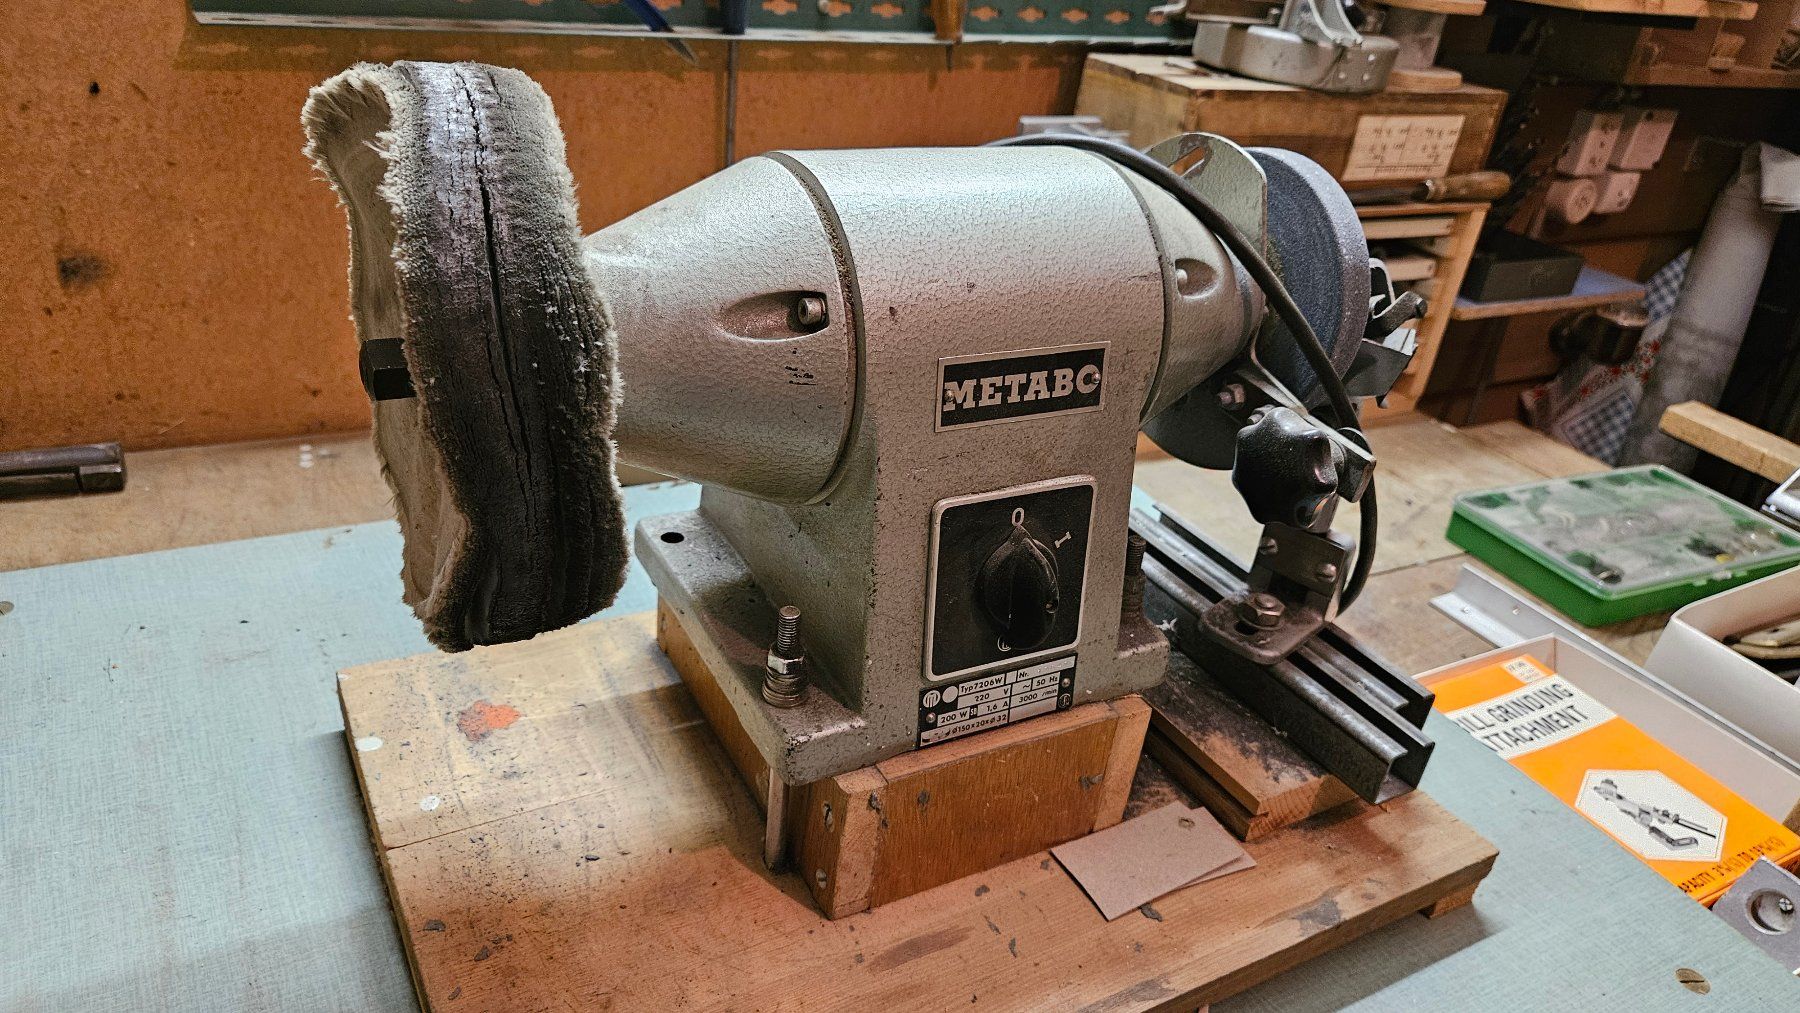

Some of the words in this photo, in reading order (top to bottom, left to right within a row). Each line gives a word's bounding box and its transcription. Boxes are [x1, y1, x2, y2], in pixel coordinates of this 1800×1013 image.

[942, 364, 1101, 412] METABO
[1019, 670, 1029, 679] Nr.
[1036, 679, 1046, 687] 50
[1049, 675, 1058, 683] Hz
[974, 693, 990, 702] 220
[1003, 688, 1009, 696] V
[1019, 693, 1038, 703] 3000
[1452, 713, 1496, 734] ILL
[1487, 682, 1574, 723] GRINDING
[941, 714, 957, 724] 200
[960, 711, 968, 719] W
[1481, 704, 1589, 752] TTACHMENT
